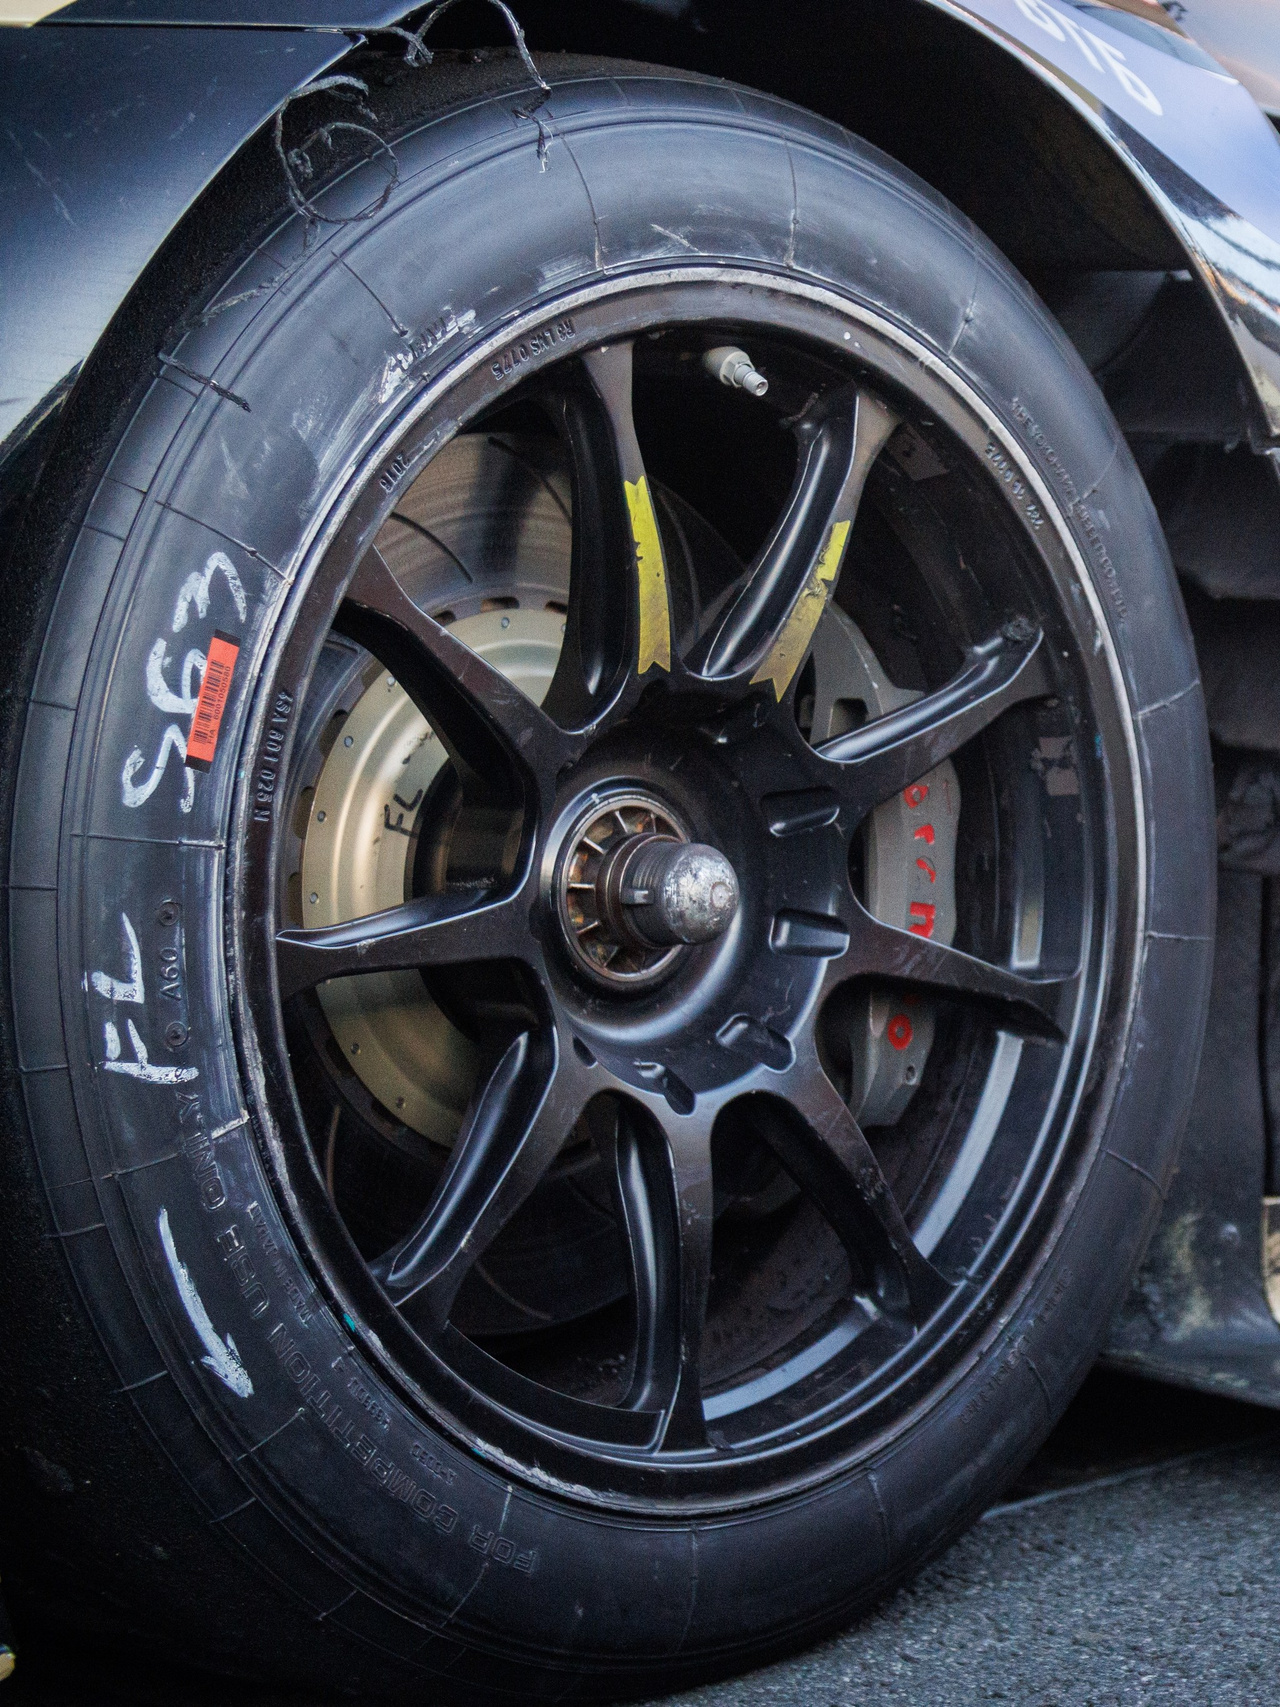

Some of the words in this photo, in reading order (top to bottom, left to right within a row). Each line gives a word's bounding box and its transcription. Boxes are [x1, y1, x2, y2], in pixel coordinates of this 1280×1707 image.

[159, 946, 184, 1000] A60
[175, 1090, 227, 1213] ONLY
[215, 1224, 270, 1320] USE
[266, 1322, 458, 1533] COMPETITION
[468, 1524, 537, 1573] FOR
